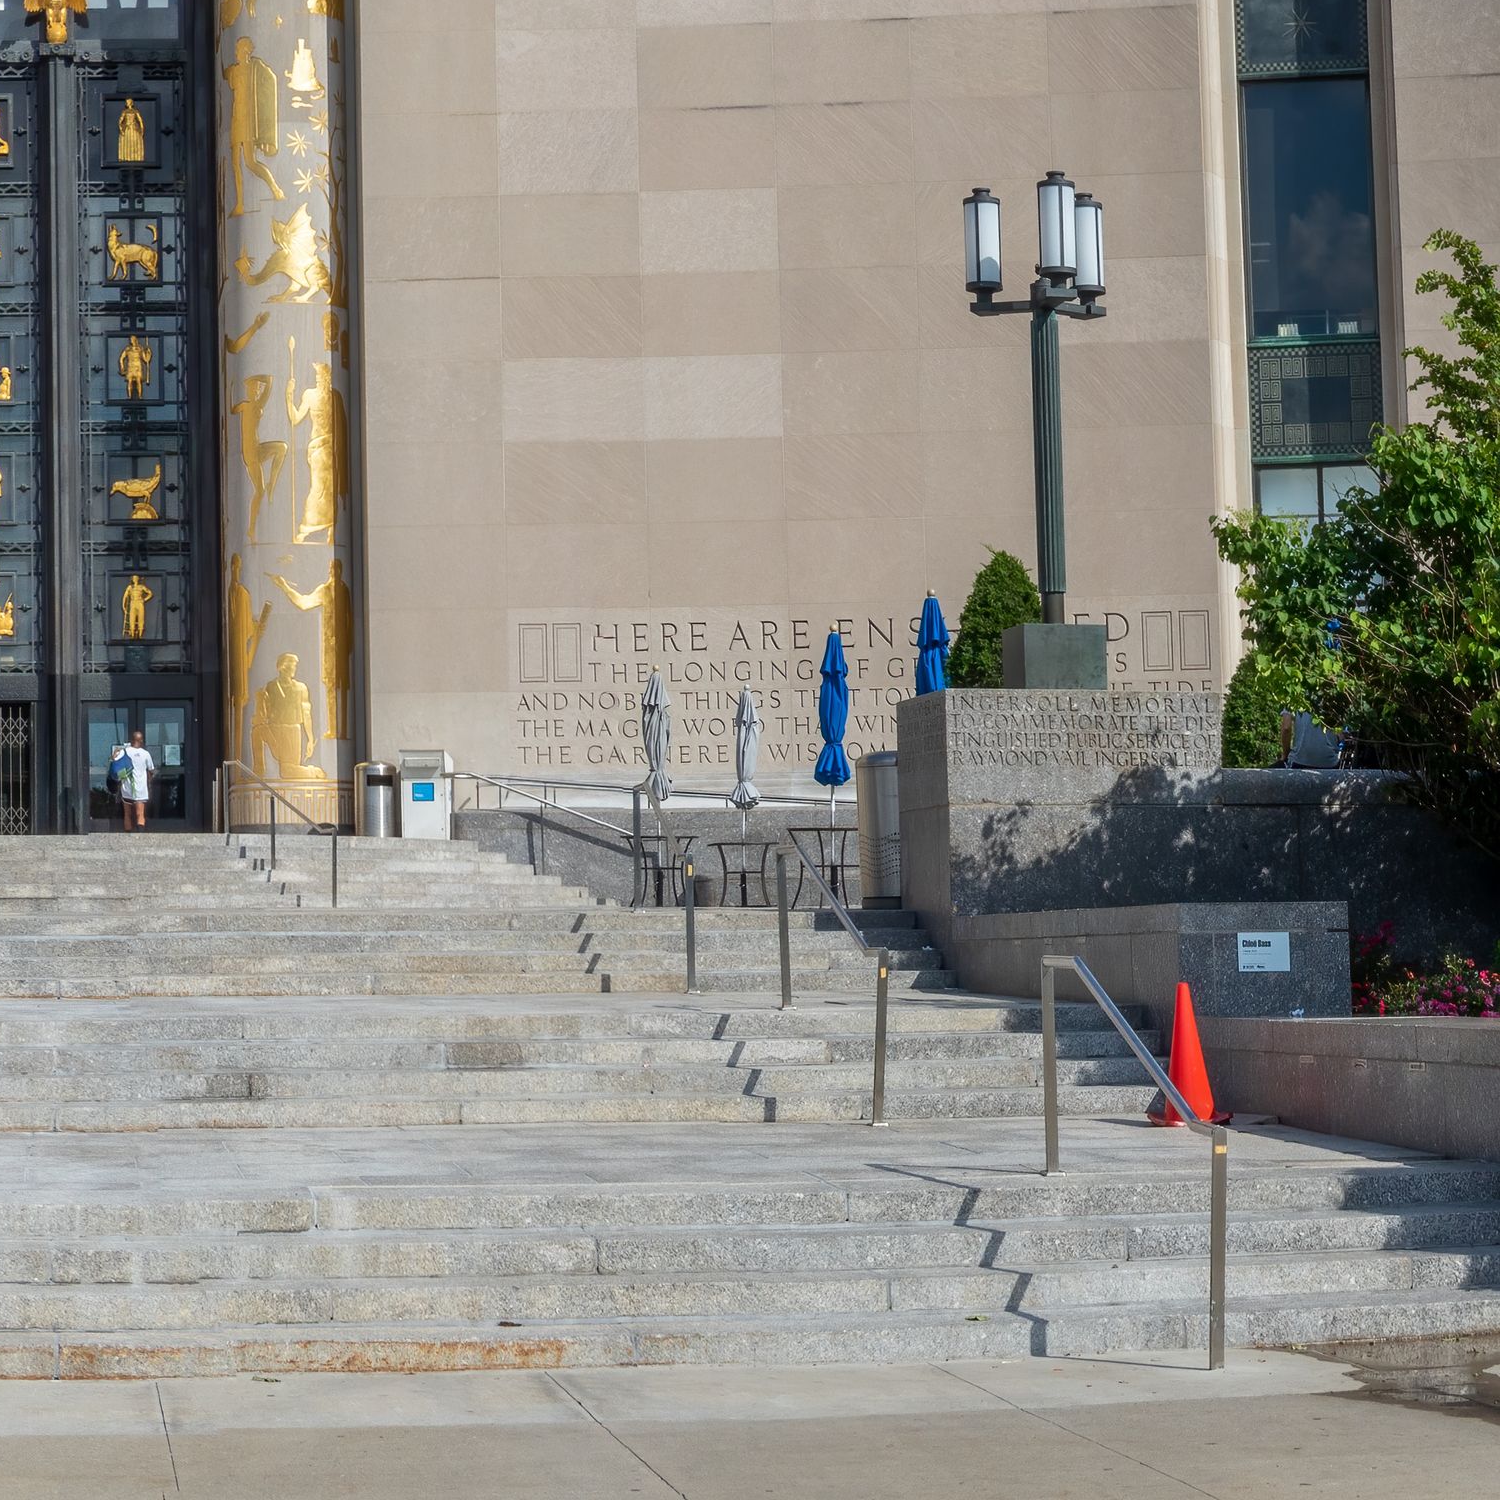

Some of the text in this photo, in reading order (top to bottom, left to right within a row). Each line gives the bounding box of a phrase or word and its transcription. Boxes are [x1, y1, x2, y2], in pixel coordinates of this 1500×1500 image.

[592, 621, 708, 652] HERE
[728, 620, 811, 651] ARE
[588, 662, 649, 683] THE
[669, 659, 814, 683] LONGING
[517, 692, 568, 711] AND
[794, 688, 860, 708] THT
[952, 696, 1214, 714] INGERSOLL MEMORIAL
[517, 719, 565, 738] THE
[952, 714, 975, 730] TO
[983, 714, 1138, 731] COMMEMORATE
[1147, 715, 1178, 731] THE
[951, 731, 1216, 750] TINGUISHED PUBLIC SERVICE OF
[517, 745, 572, 765] THE
[952, 750, 1047, 767] RAYMOND
[1049, 750, 1090, 767] VAIL
[1095, 750, 1192, 768] INGERSOLL
